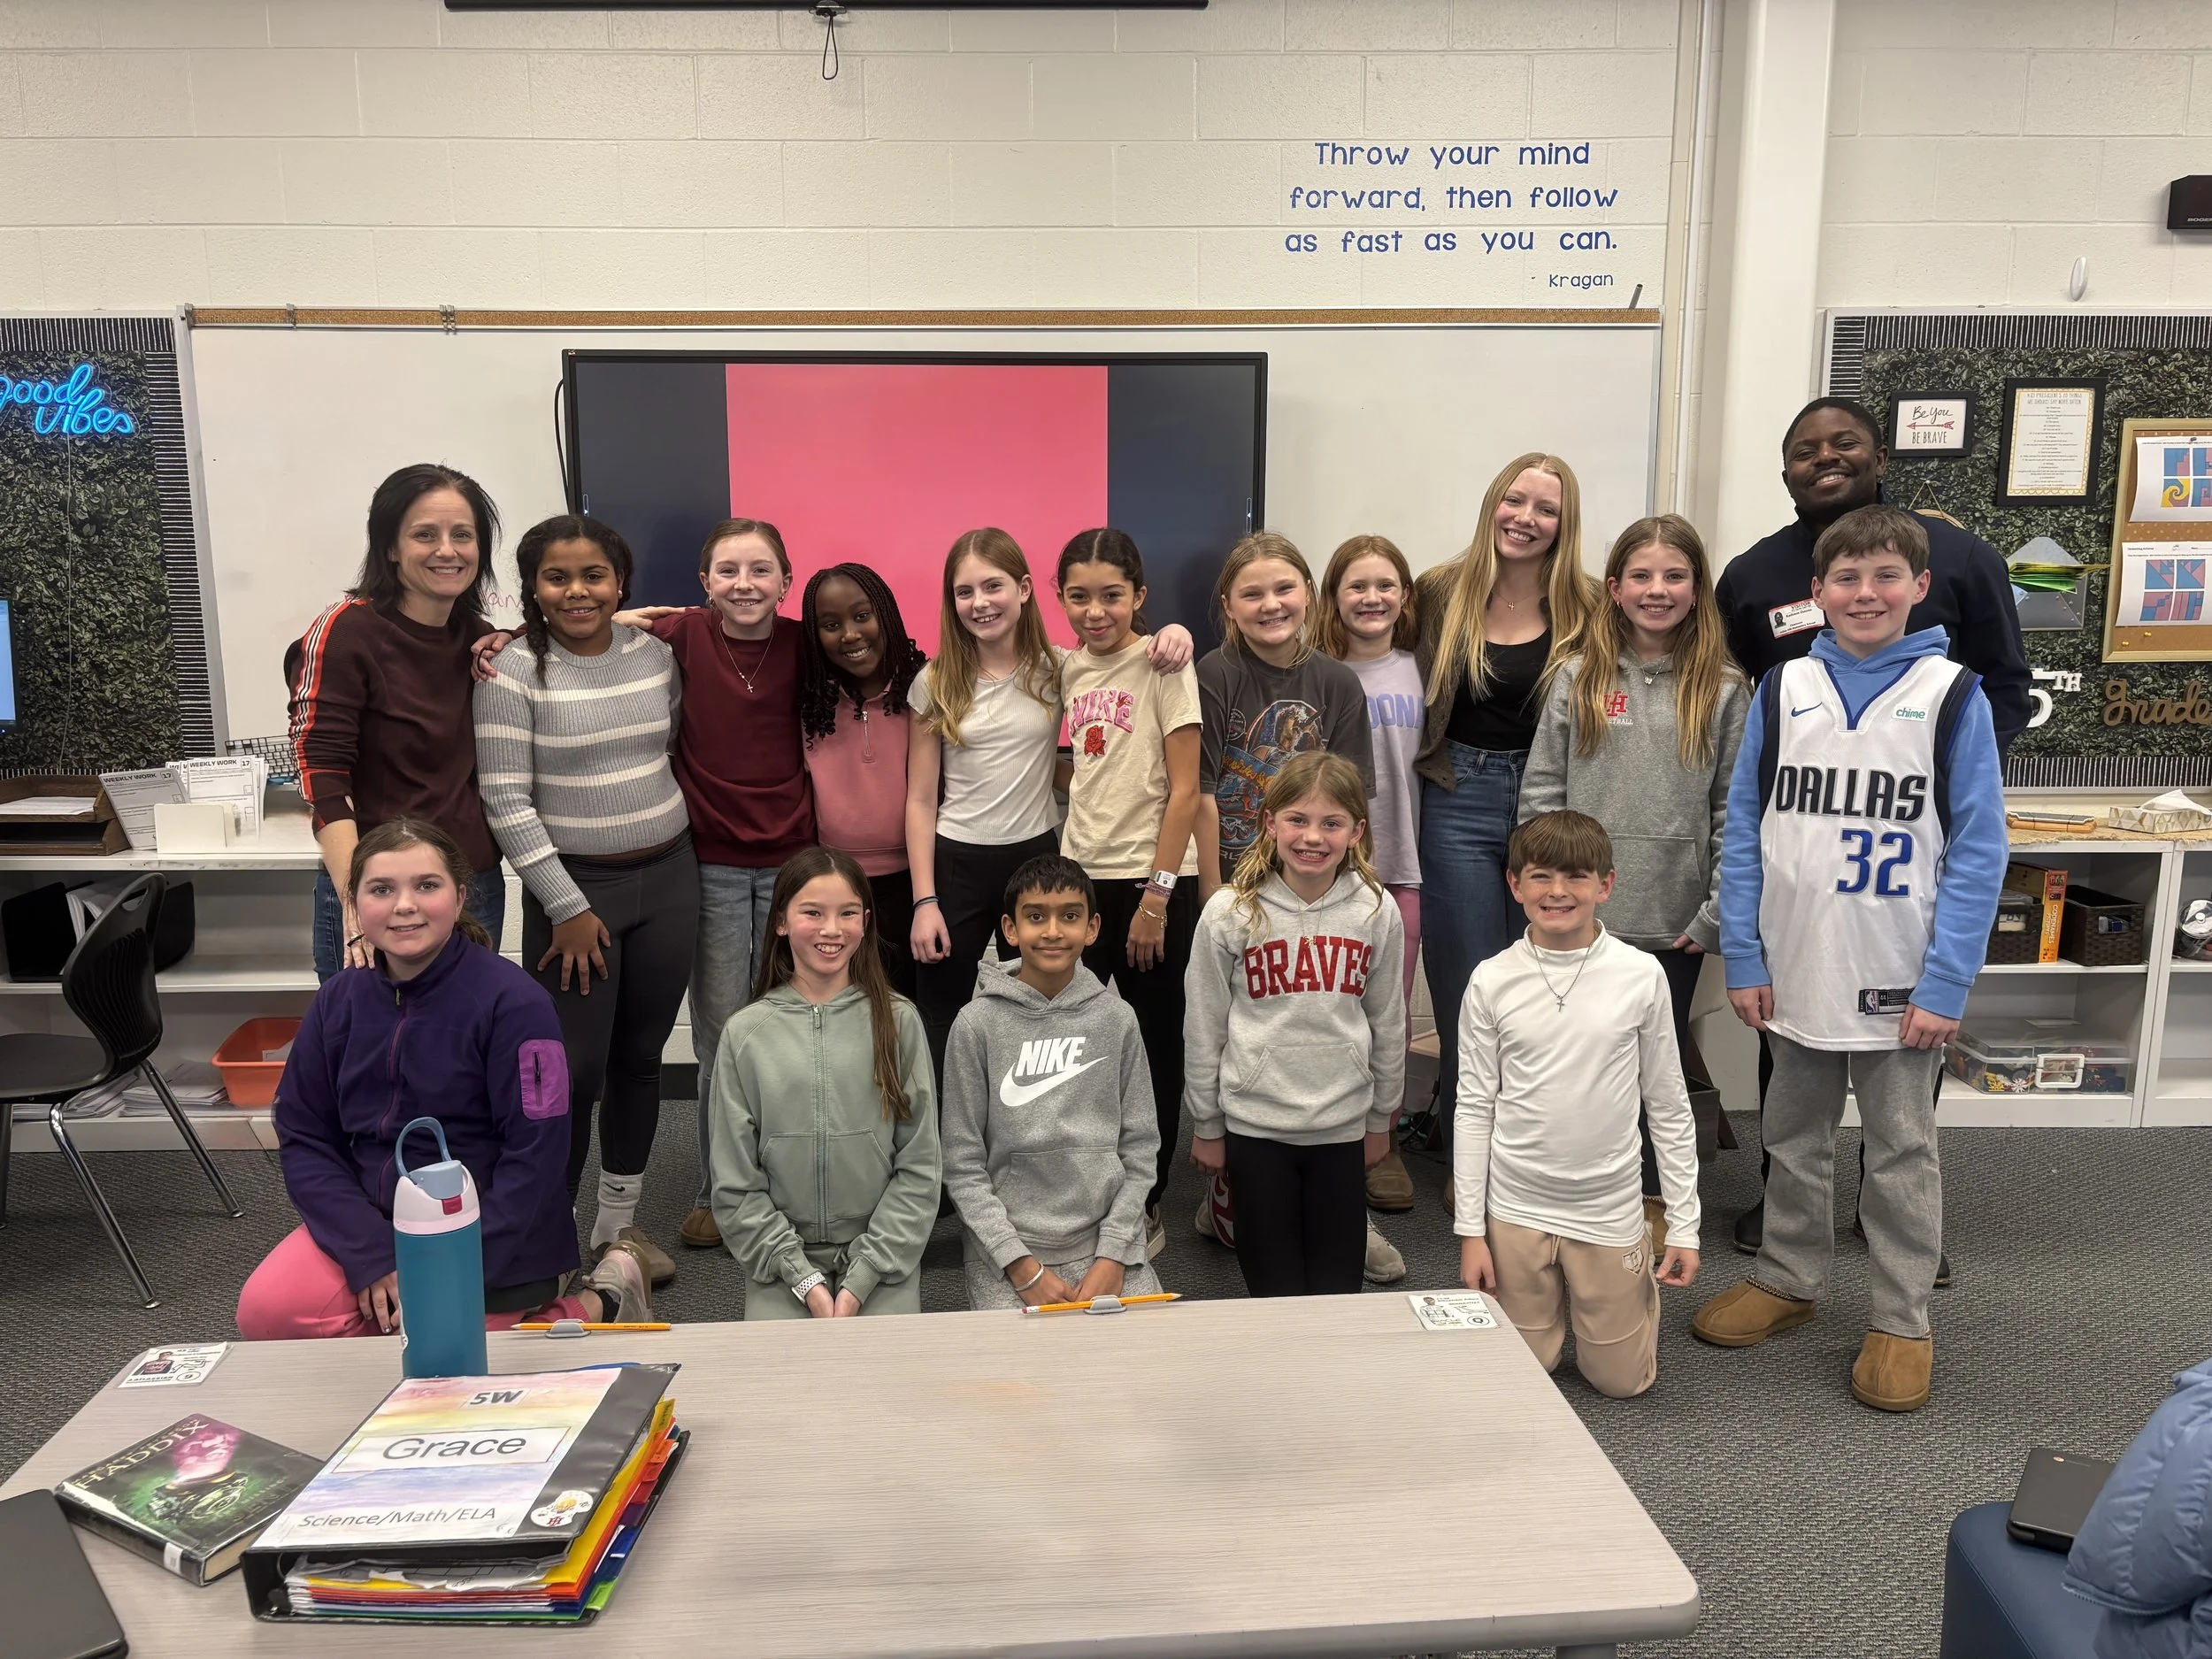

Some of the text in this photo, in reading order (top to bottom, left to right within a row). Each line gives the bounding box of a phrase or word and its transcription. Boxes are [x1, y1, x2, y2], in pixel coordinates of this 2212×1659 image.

[1315, 142, 1590, 170] Throw your mind
[1290, 186, 1618, 211] forward, then follow
[1285, 230, 1618, 254] as fast as you can.
[1548, 273, 1614, 289] Kragan
[1912, 405, 1929, 420] Be
[1912, 431, 1947, 443] BE BRAVE
[1069, 689, 1134, 736] NIKE
[1896, 707, 1925, 718] chime
[1776, 765, 1927, 823] DALLAS
[1836, 828, 1914, 898] 32
[1245, 935, 1371, 1000] BRAVES
[1015, 1037, 1086, 1076] NIKE
[470, 1391, 524, 1405] 5W
[75, 1421, 210, 1489] HADDIX
[382, 1437, 526, 1459] Grace
[298, 1507, 496, 1528] Science/Math/ELA
